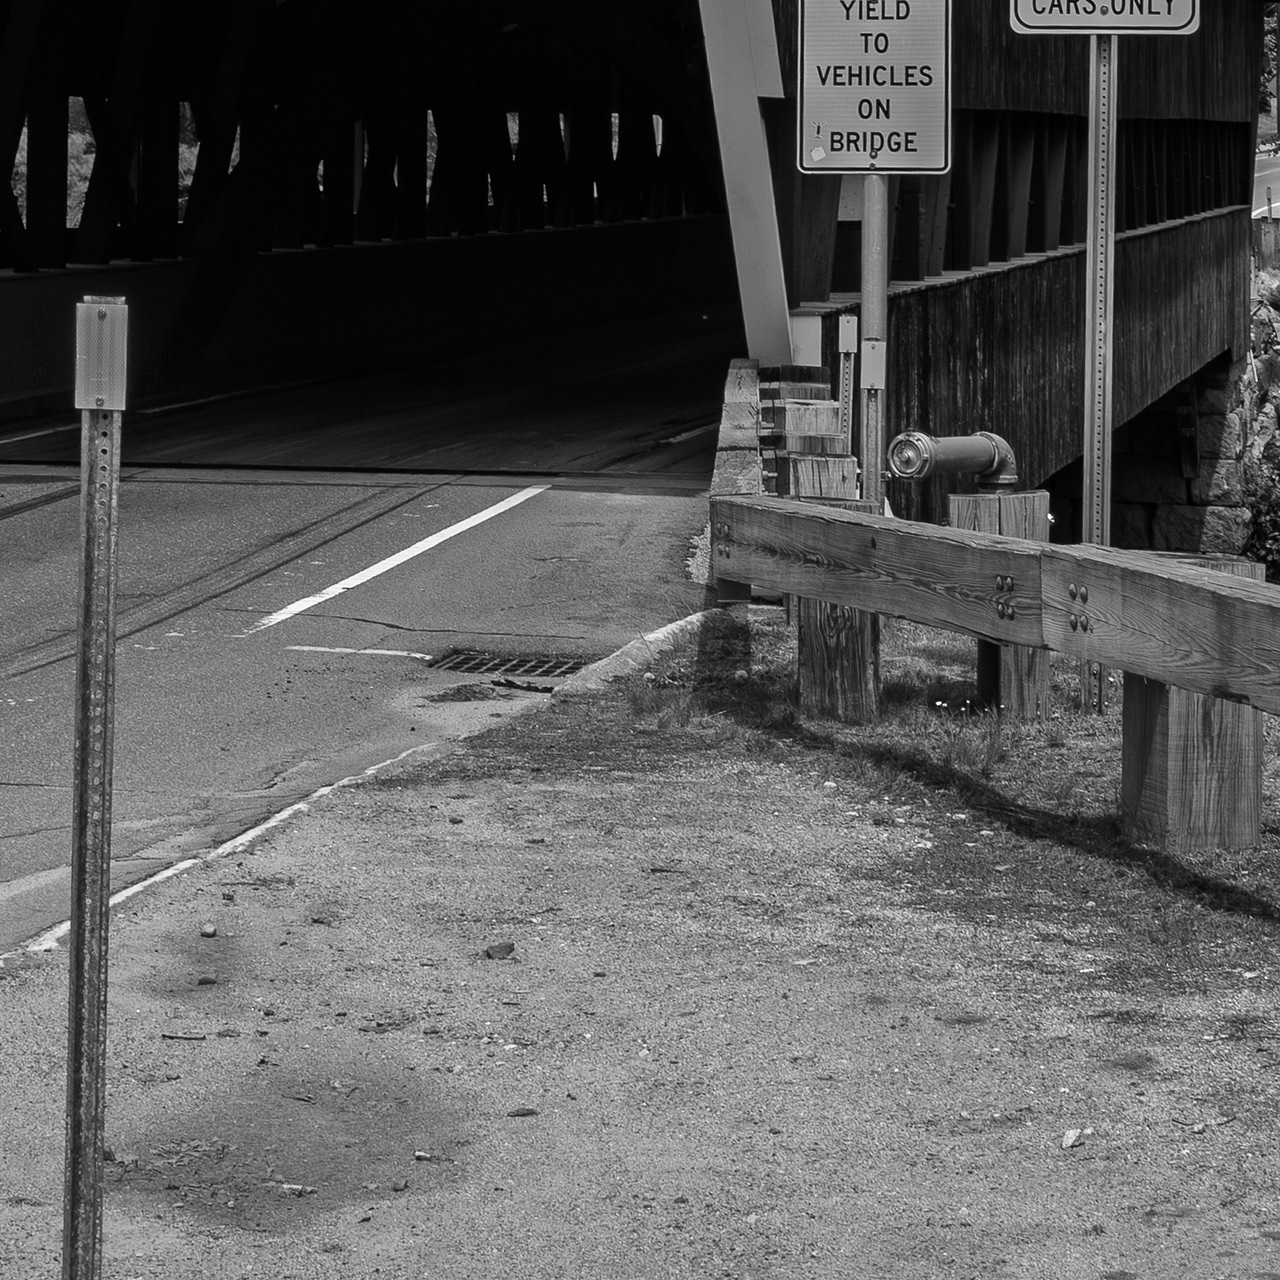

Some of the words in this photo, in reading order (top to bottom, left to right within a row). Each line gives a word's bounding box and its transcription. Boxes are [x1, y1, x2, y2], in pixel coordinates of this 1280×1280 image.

[839, 0, 911, 21] YIELD
[860, 32, 889, 54] TO
[816, 65, 933, 87] VEHICLES
[858, 98, 891, 120] ON
[829, 131, 918, 153] BRIDGE
